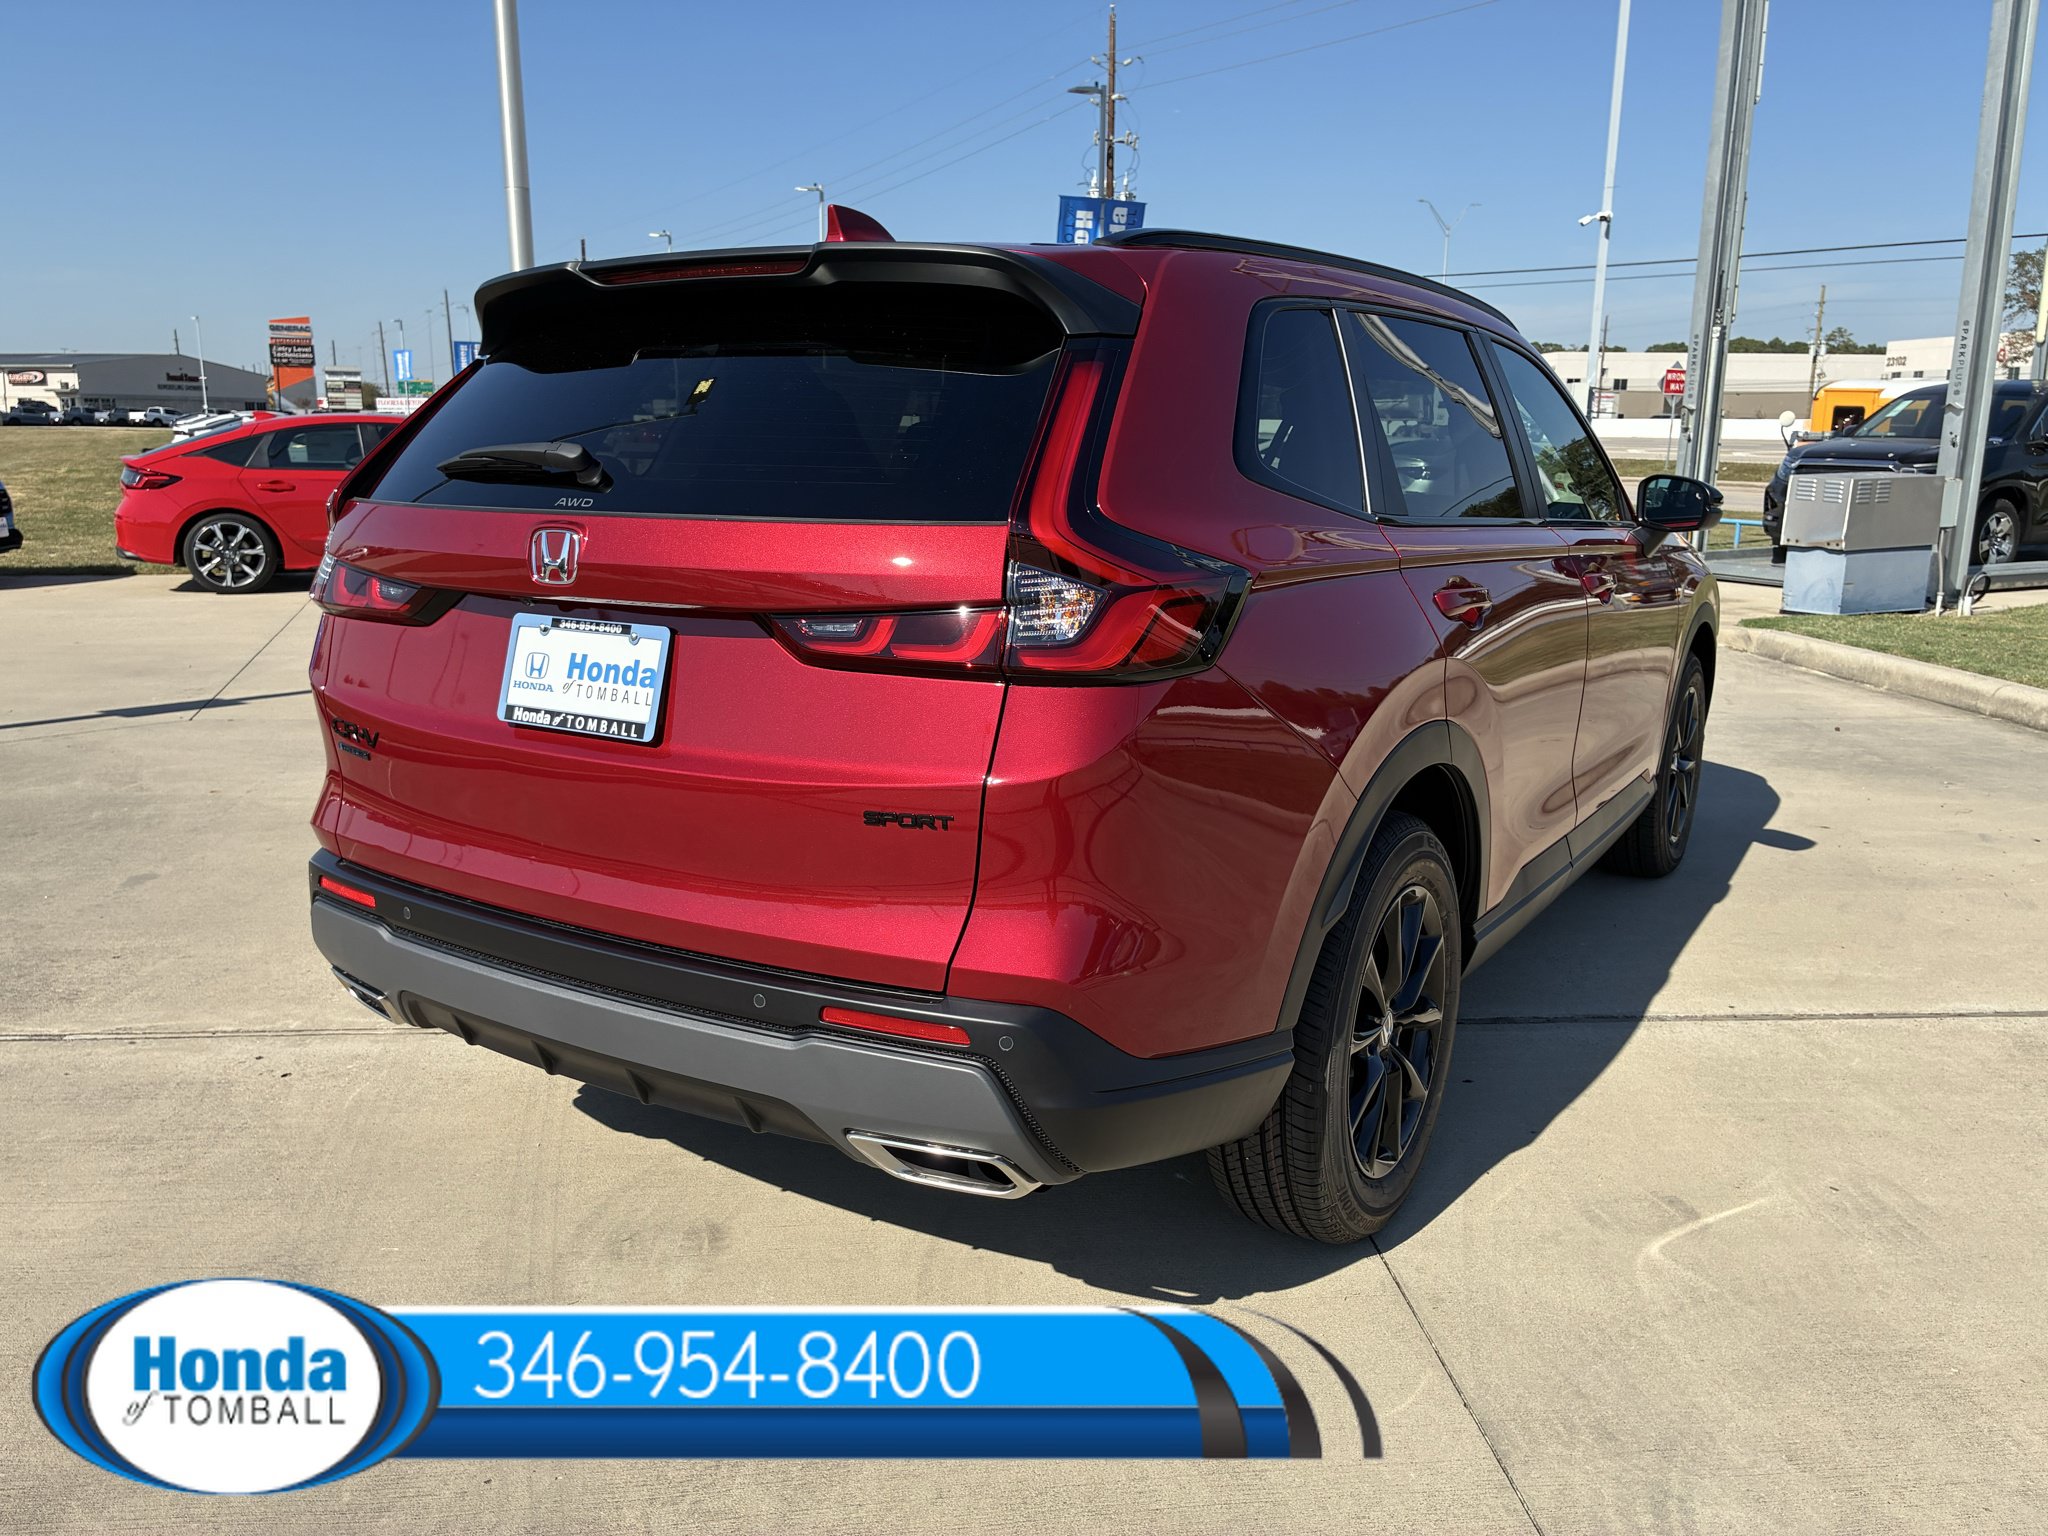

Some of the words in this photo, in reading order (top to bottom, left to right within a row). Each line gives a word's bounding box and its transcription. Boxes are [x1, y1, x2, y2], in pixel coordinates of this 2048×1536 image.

[1886, 356, 1906, 367] 23102
[1670, 382, 1684, 391] WAY
[555, 498, 593, 507] AWD
[559, 620, 622, 634] 346-954-8400
[567, 653, 657, 688] Honda
[513, 680, 554, 692] HONDA
[562, 680, 577, 694] of
[576, 684, 651, 707] TOMBALL
[513, 706, 551, 725] Honda
[552, 713, 566, 726] of
[566, 716, 638, 738] TOMBALL
[863, 810, 954, 831] SPORT
